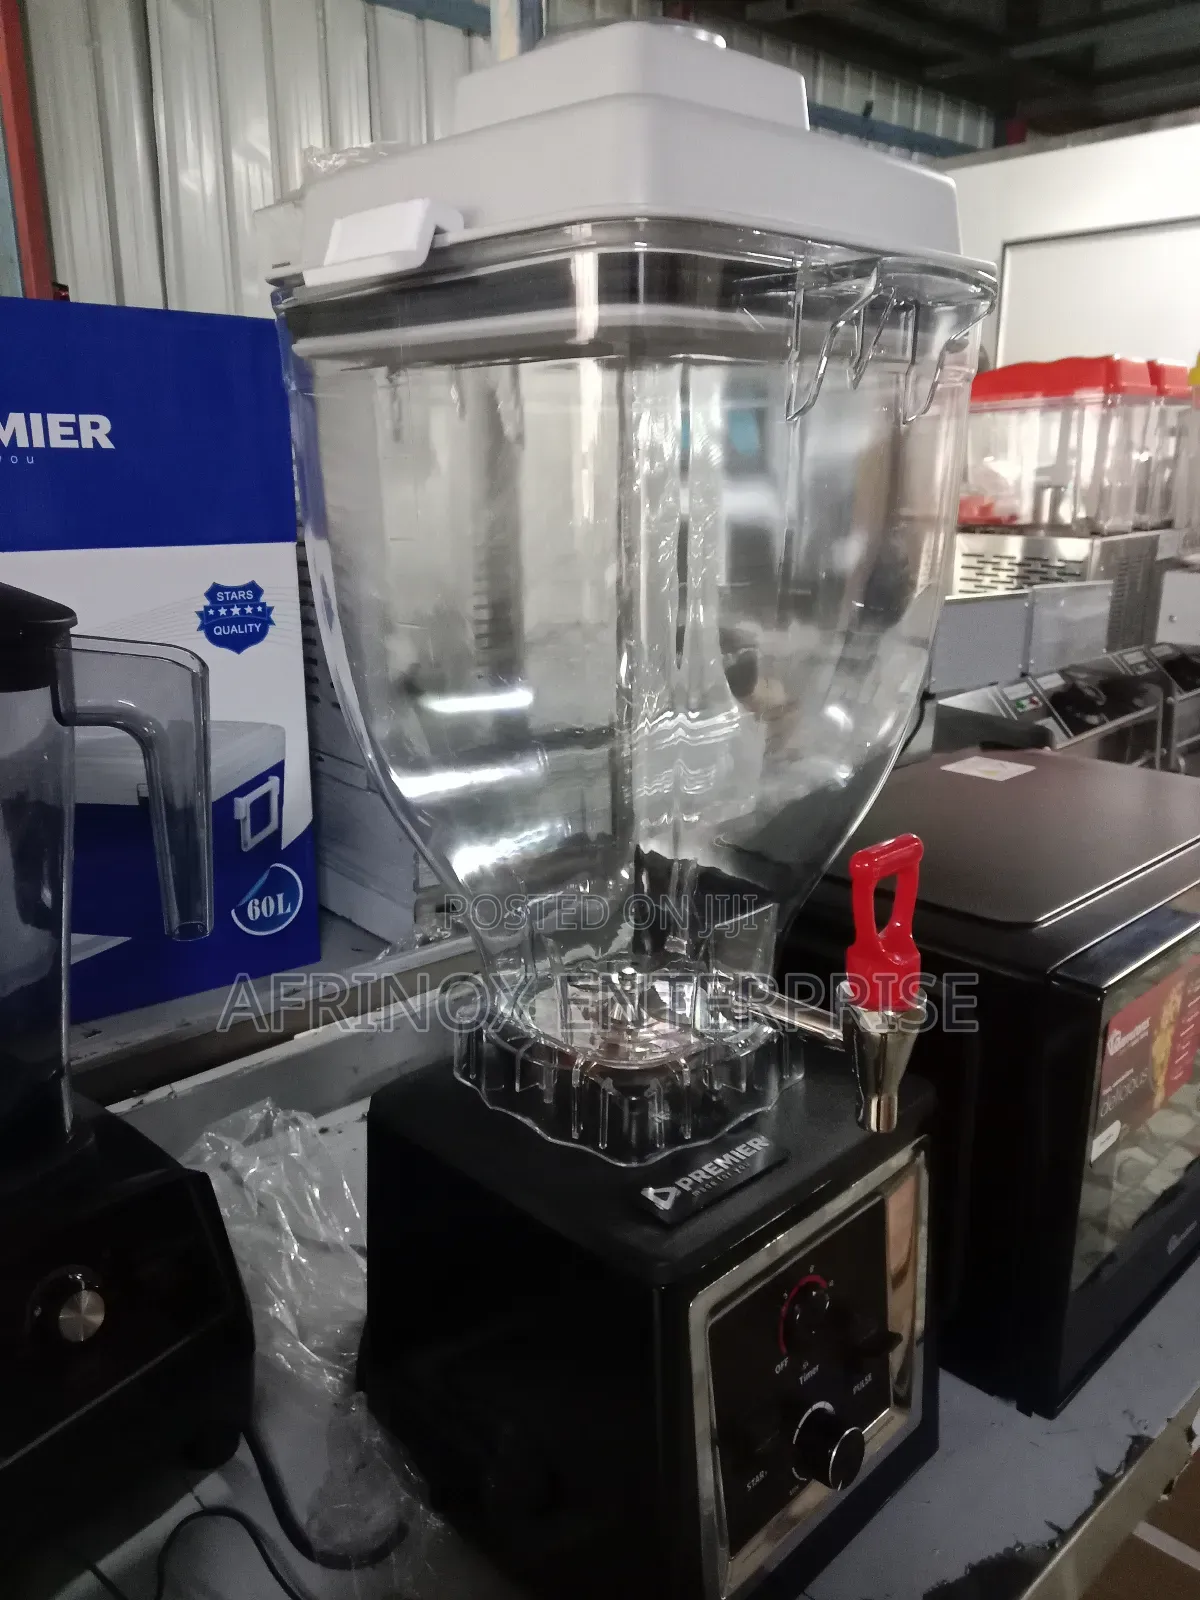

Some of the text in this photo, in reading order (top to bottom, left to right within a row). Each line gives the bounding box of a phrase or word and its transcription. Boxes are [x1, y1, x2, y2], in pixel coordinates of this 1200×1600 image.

[0, 455, 34, 464] ou
[216, 590, 254, 602] STARS
[213, 623, 262, 636] QUALITY
[247, 892, 292, 921] 60L
[674, 1135, 770, 1191] PREMIER
[774, 1356, 789, 1375] OFF
[799, 1364, 820, 1385] Timer
[852, 1372, 873, 1395] PULSE
